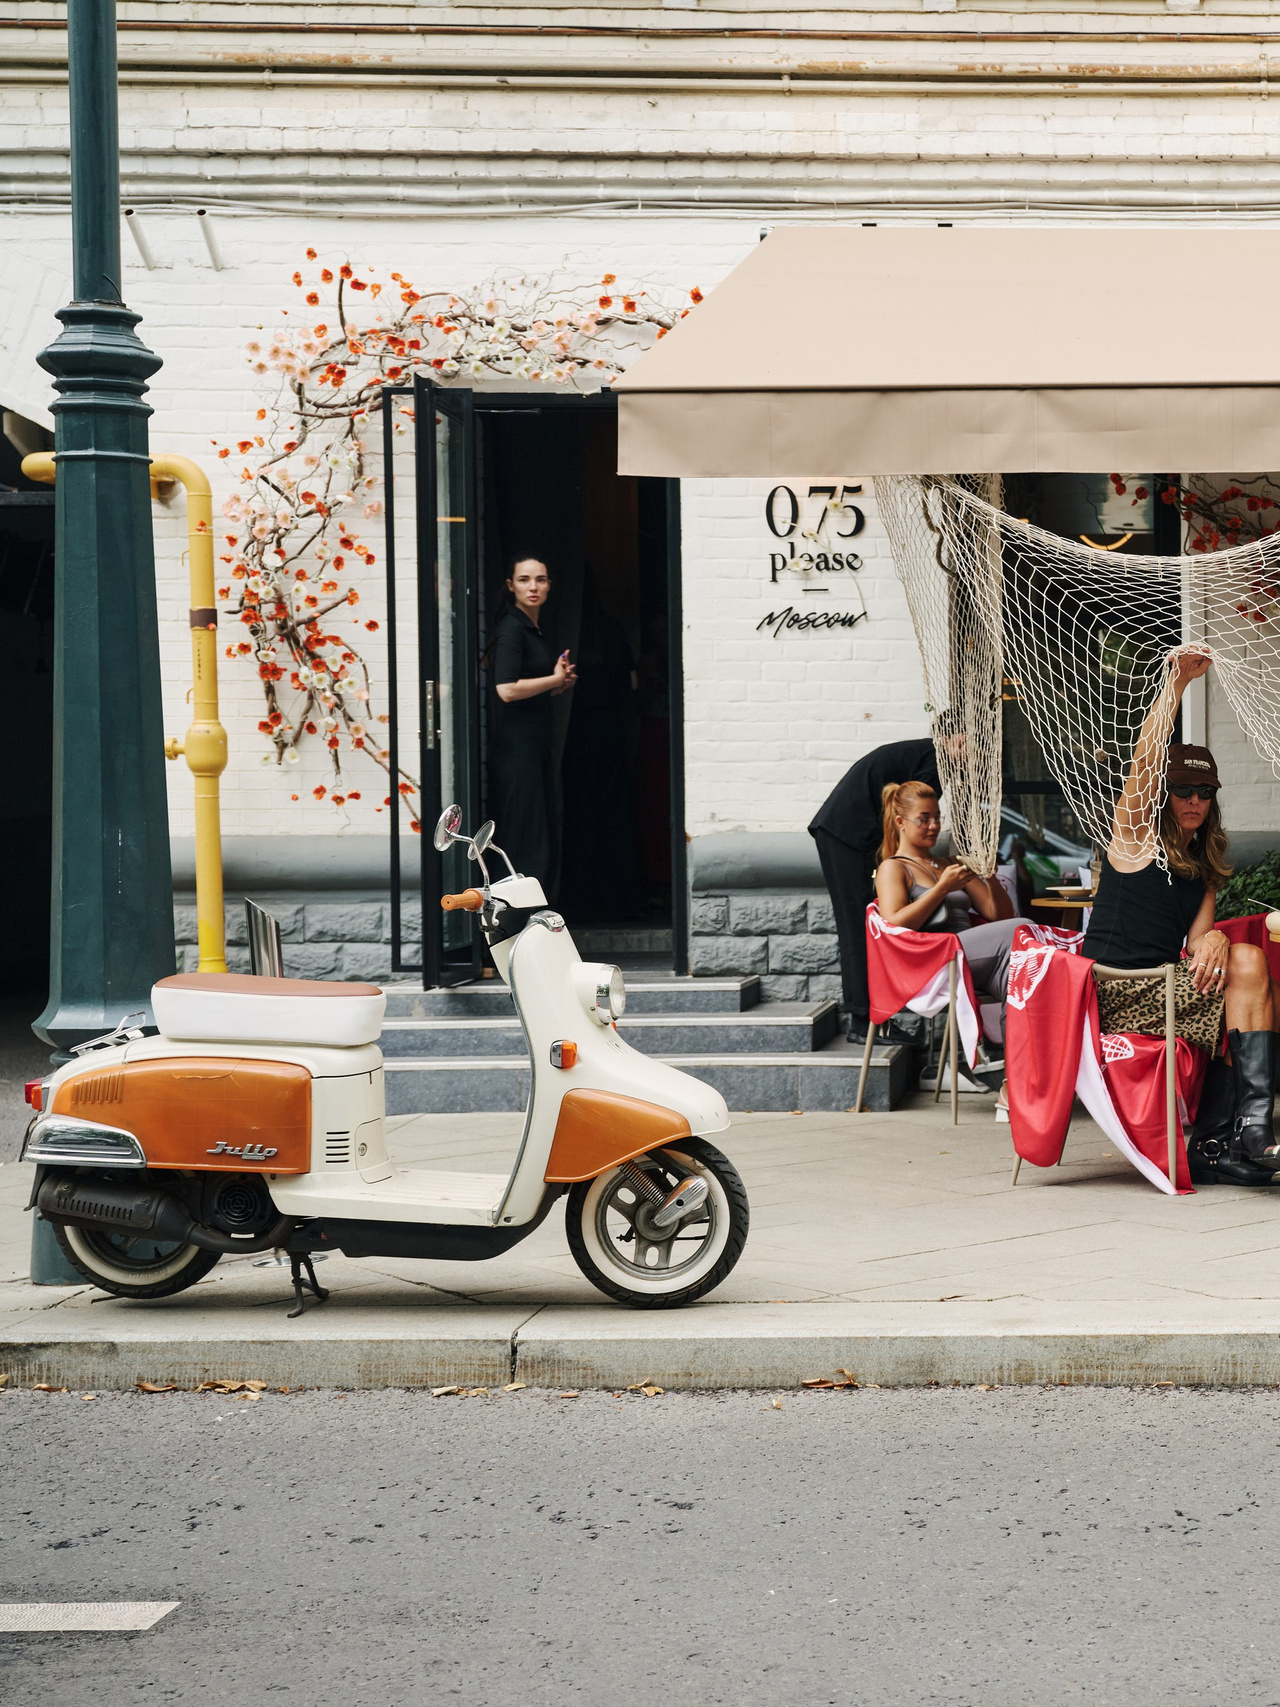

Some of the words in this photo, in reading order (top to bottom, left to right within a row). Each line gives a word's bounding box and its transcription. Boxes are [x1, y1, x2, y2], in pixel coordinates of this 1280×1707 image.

[768, 541, 864, 583] please
[756, 606, 867, 638] Moscow
[205, 1141, 278, 1158] Julio
